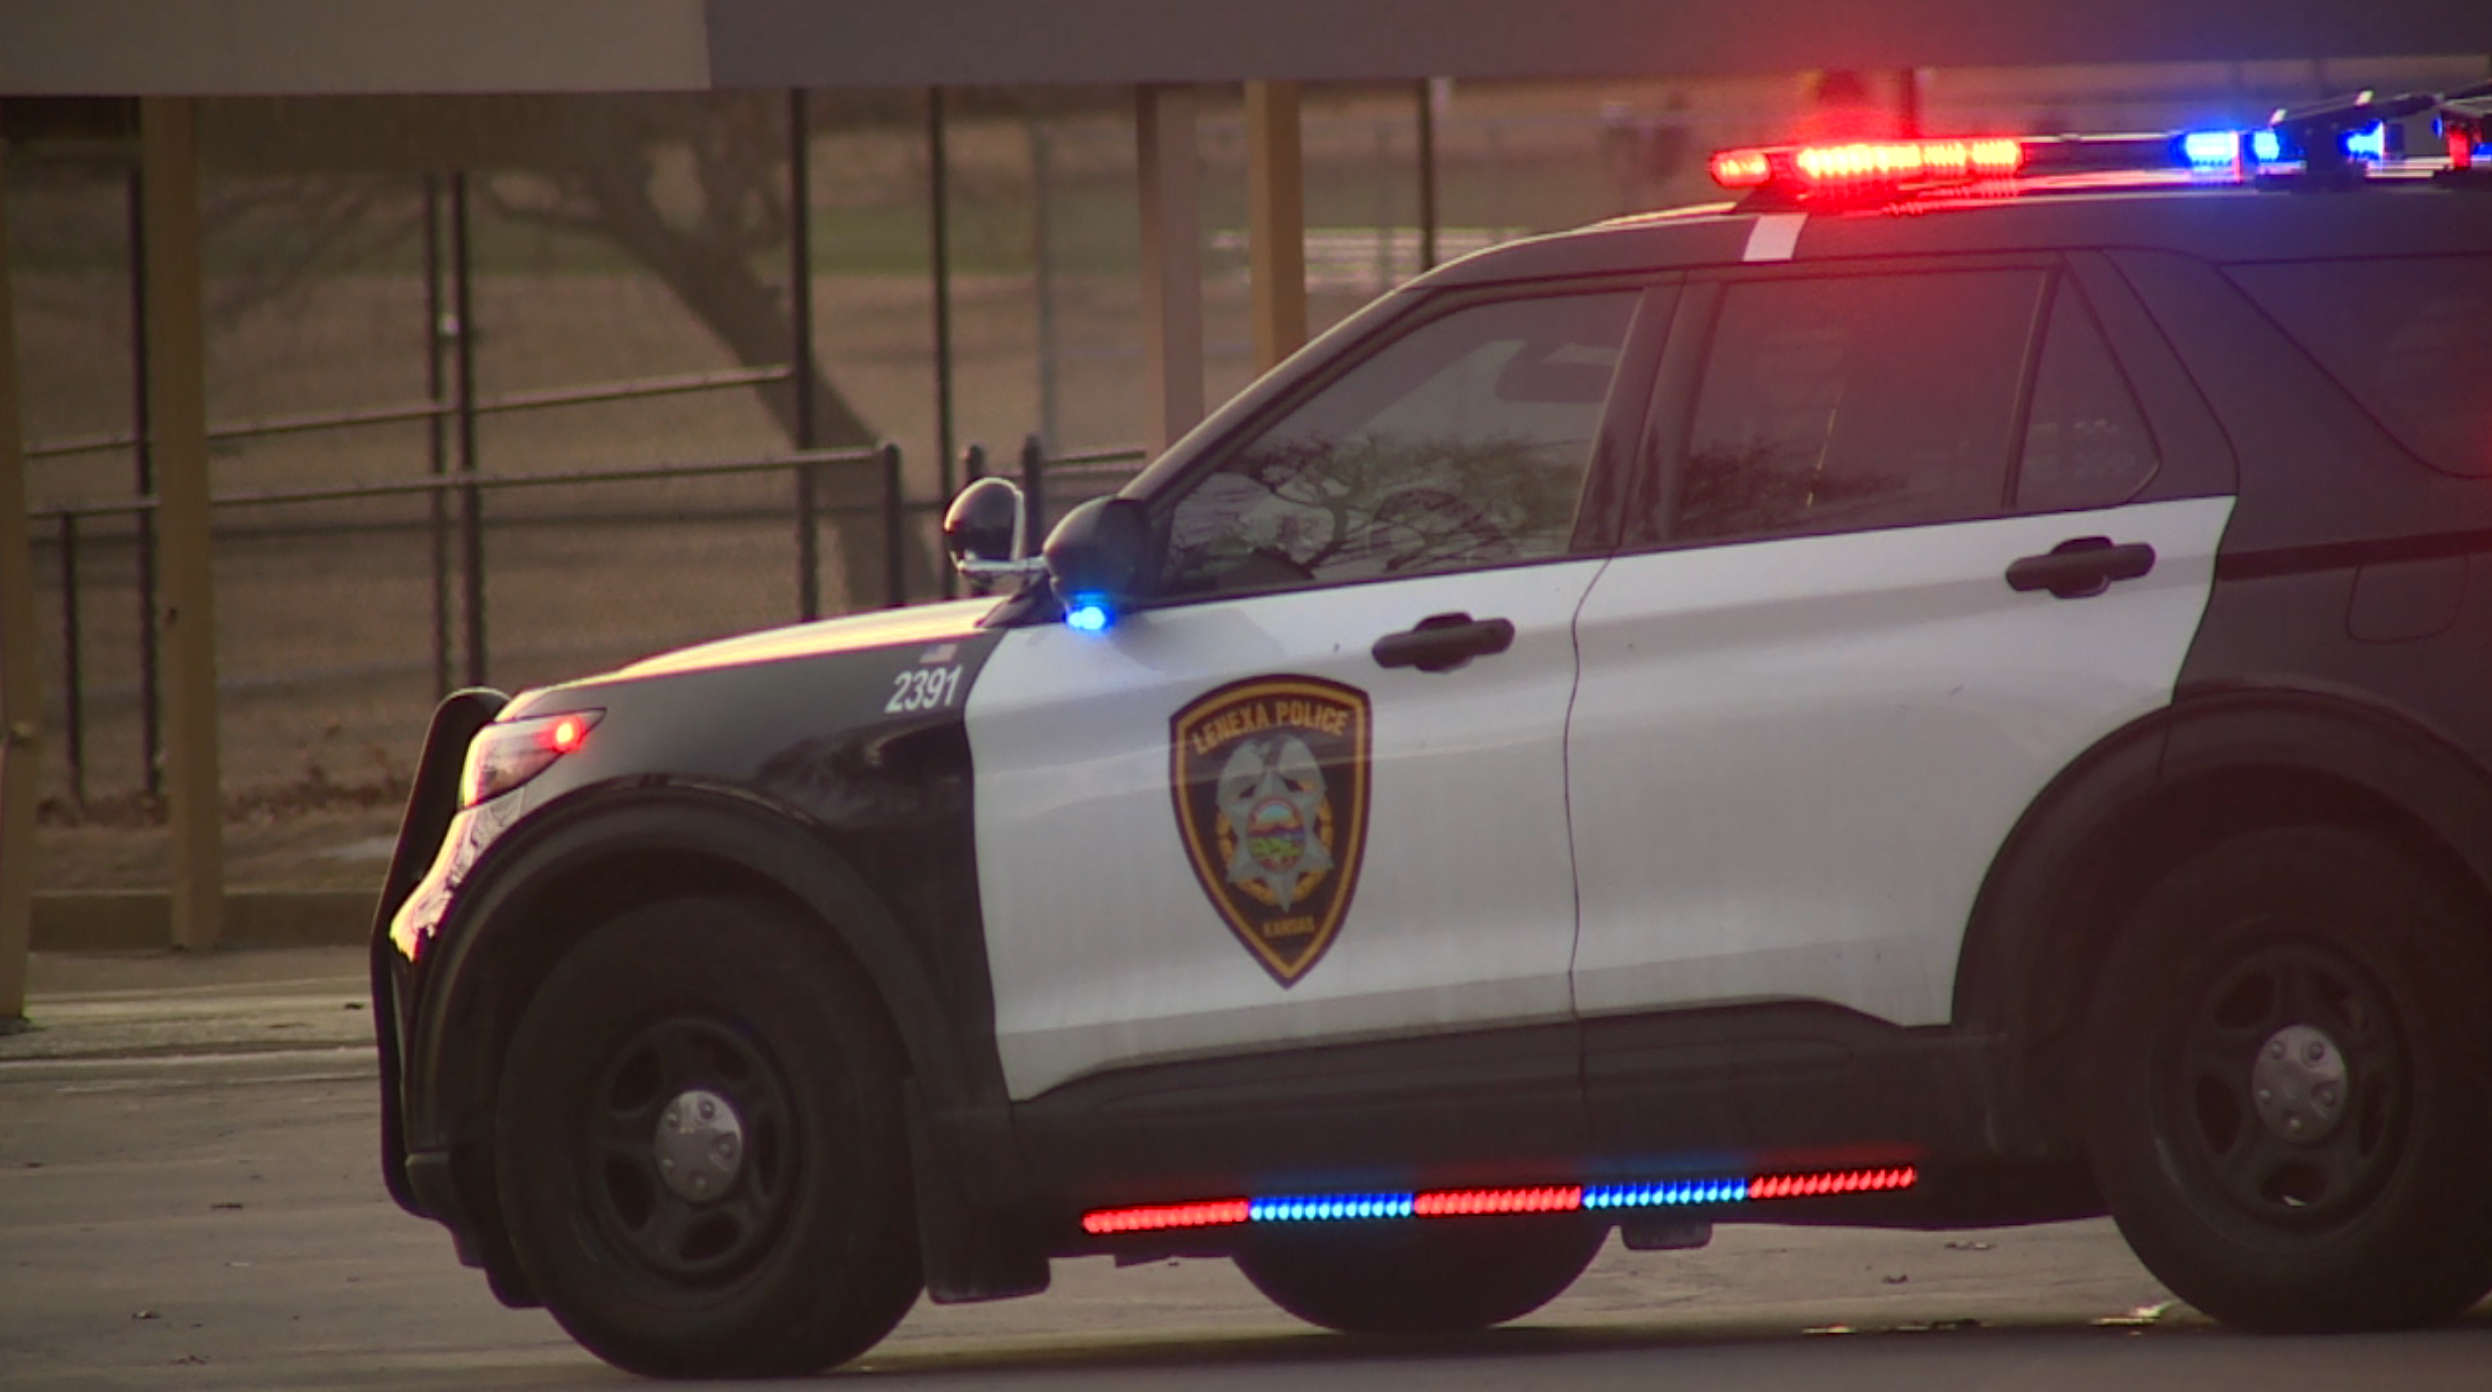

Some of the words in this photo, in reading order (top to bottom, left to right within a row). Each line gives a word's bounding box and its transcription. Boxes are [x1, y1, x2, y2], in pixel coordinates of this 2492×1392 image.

[884, 665, 963, 713] 2391
[1193, 704, 1270, 755] LENEXA
[1275, 702, 1348, 736] POLICE
